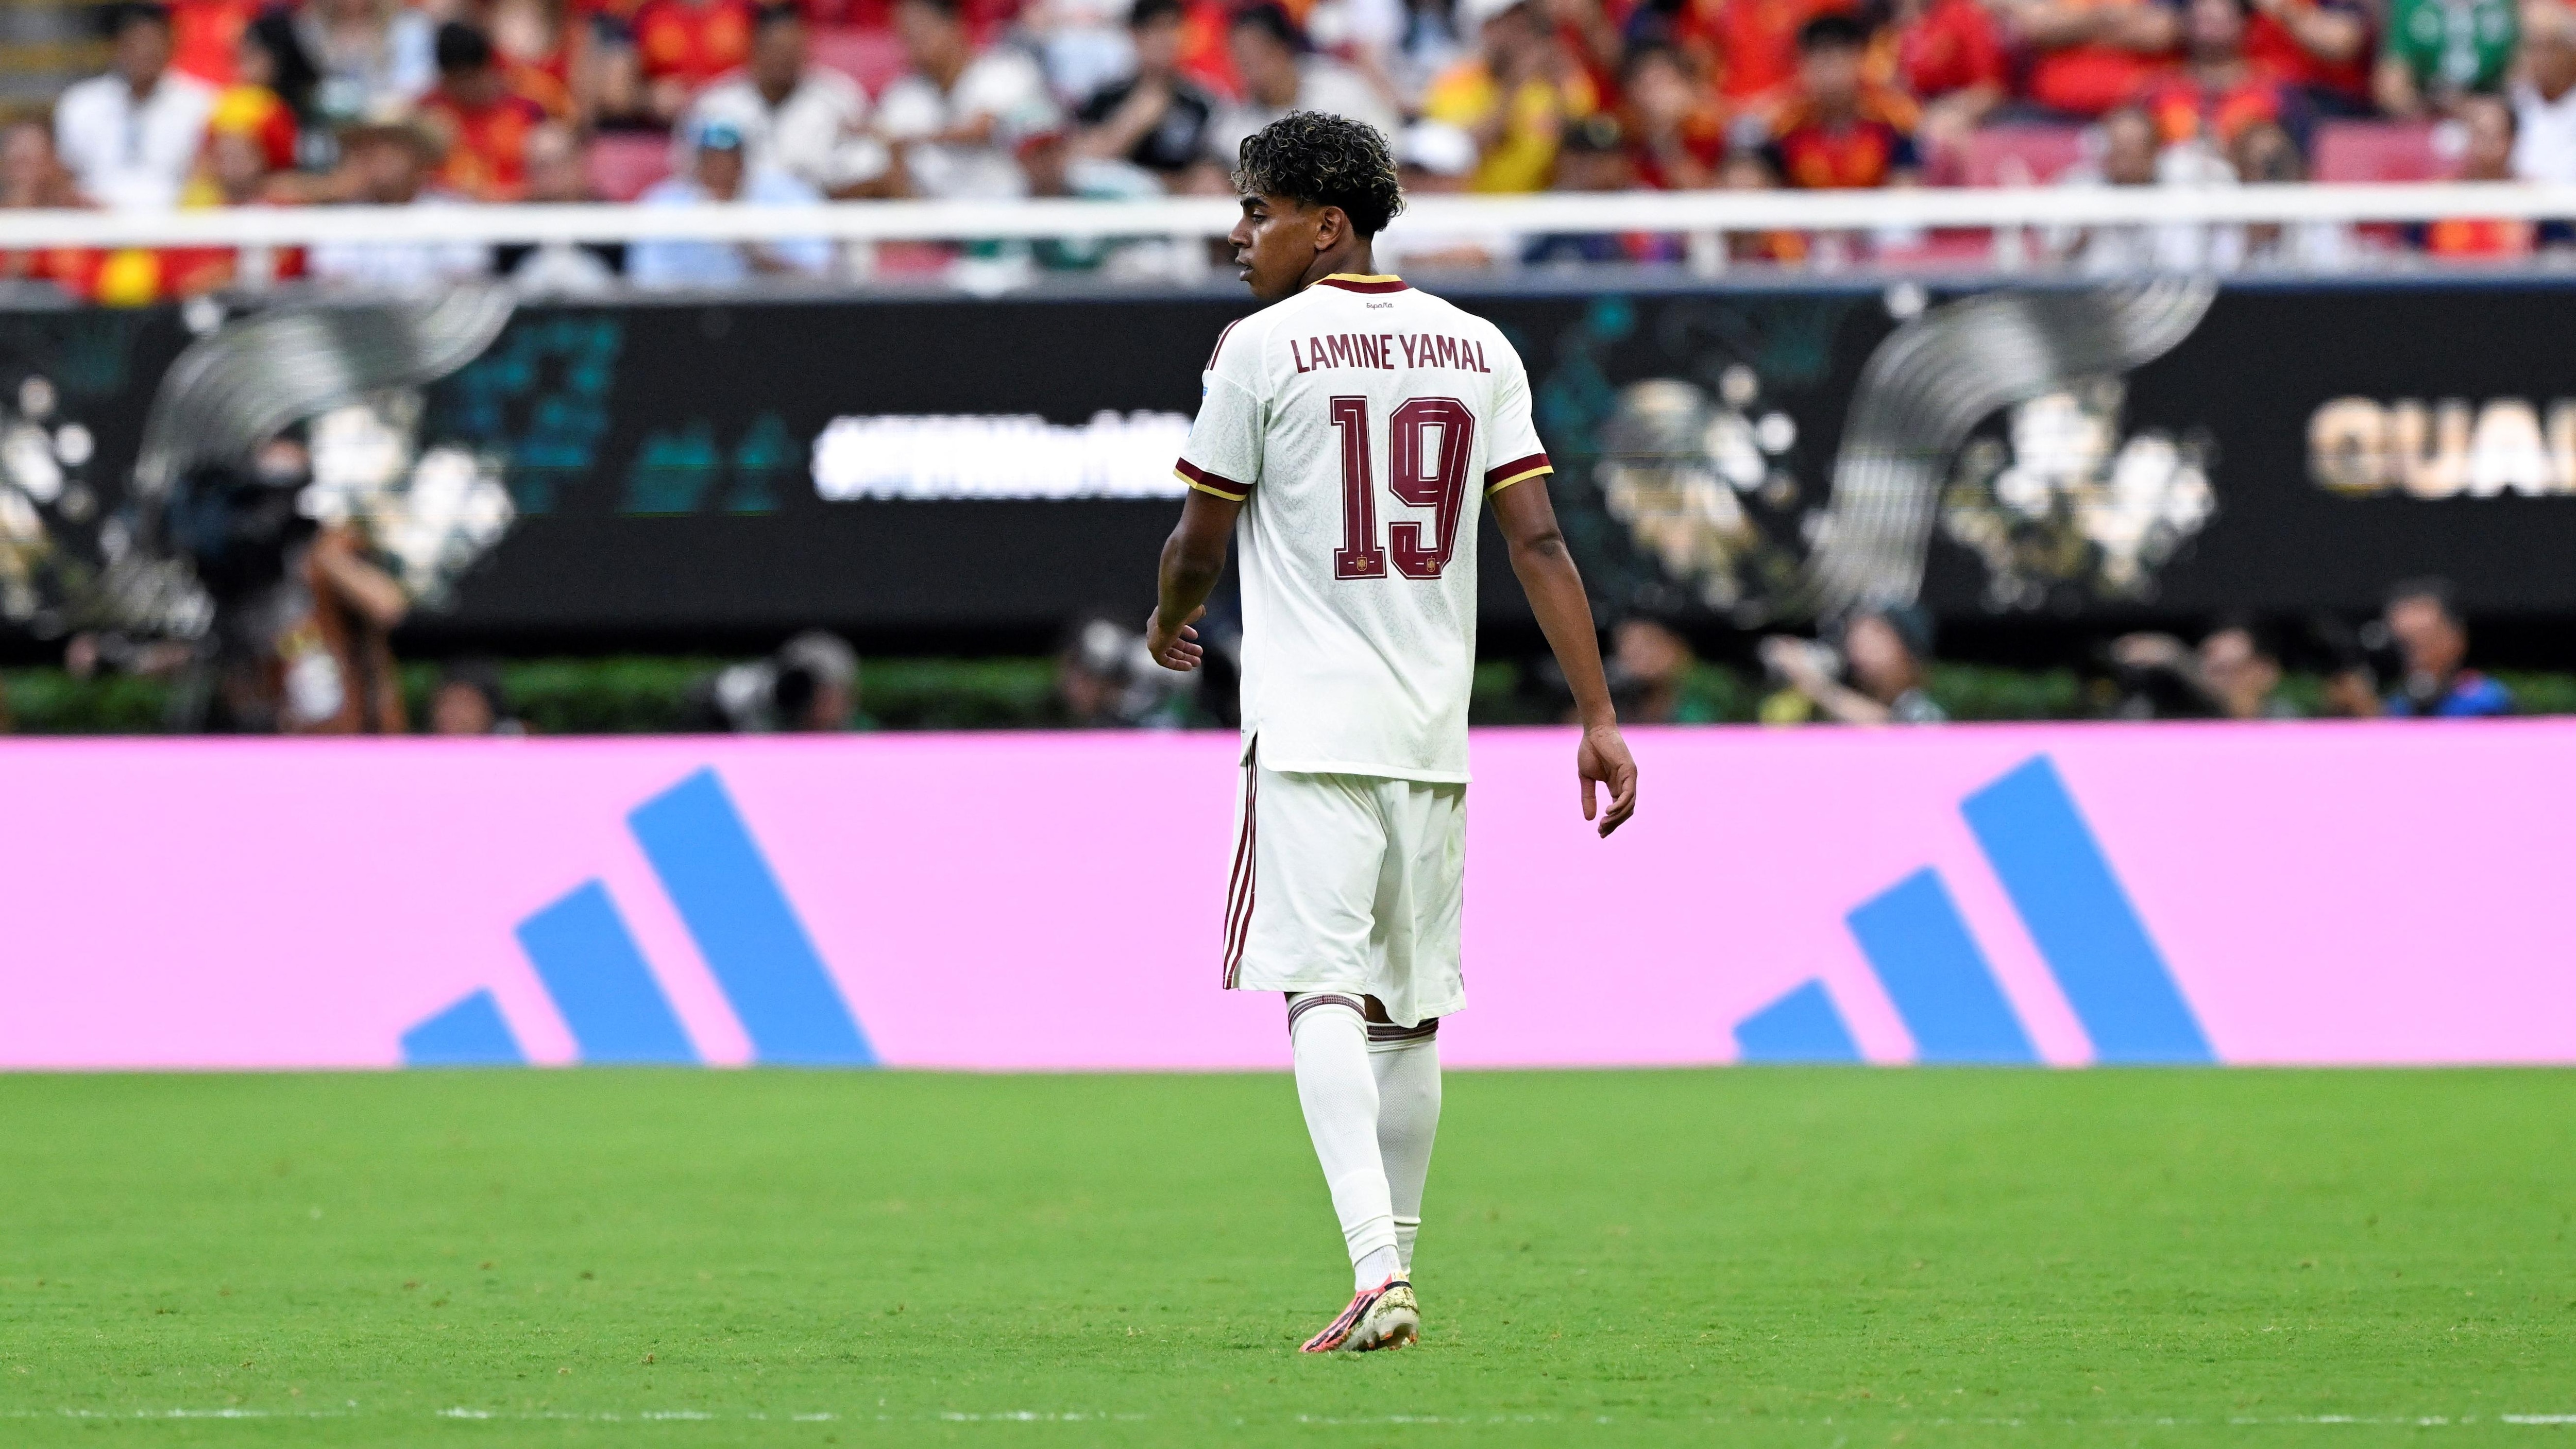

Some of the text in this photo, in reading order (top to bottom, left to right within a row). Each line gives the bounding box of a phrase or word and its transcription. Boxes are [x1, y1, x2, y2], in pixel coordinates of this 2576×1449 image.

[1290, 334, 1491, 374] LAMINE YAMAL
[1329, 395, 1476, 581] 19
